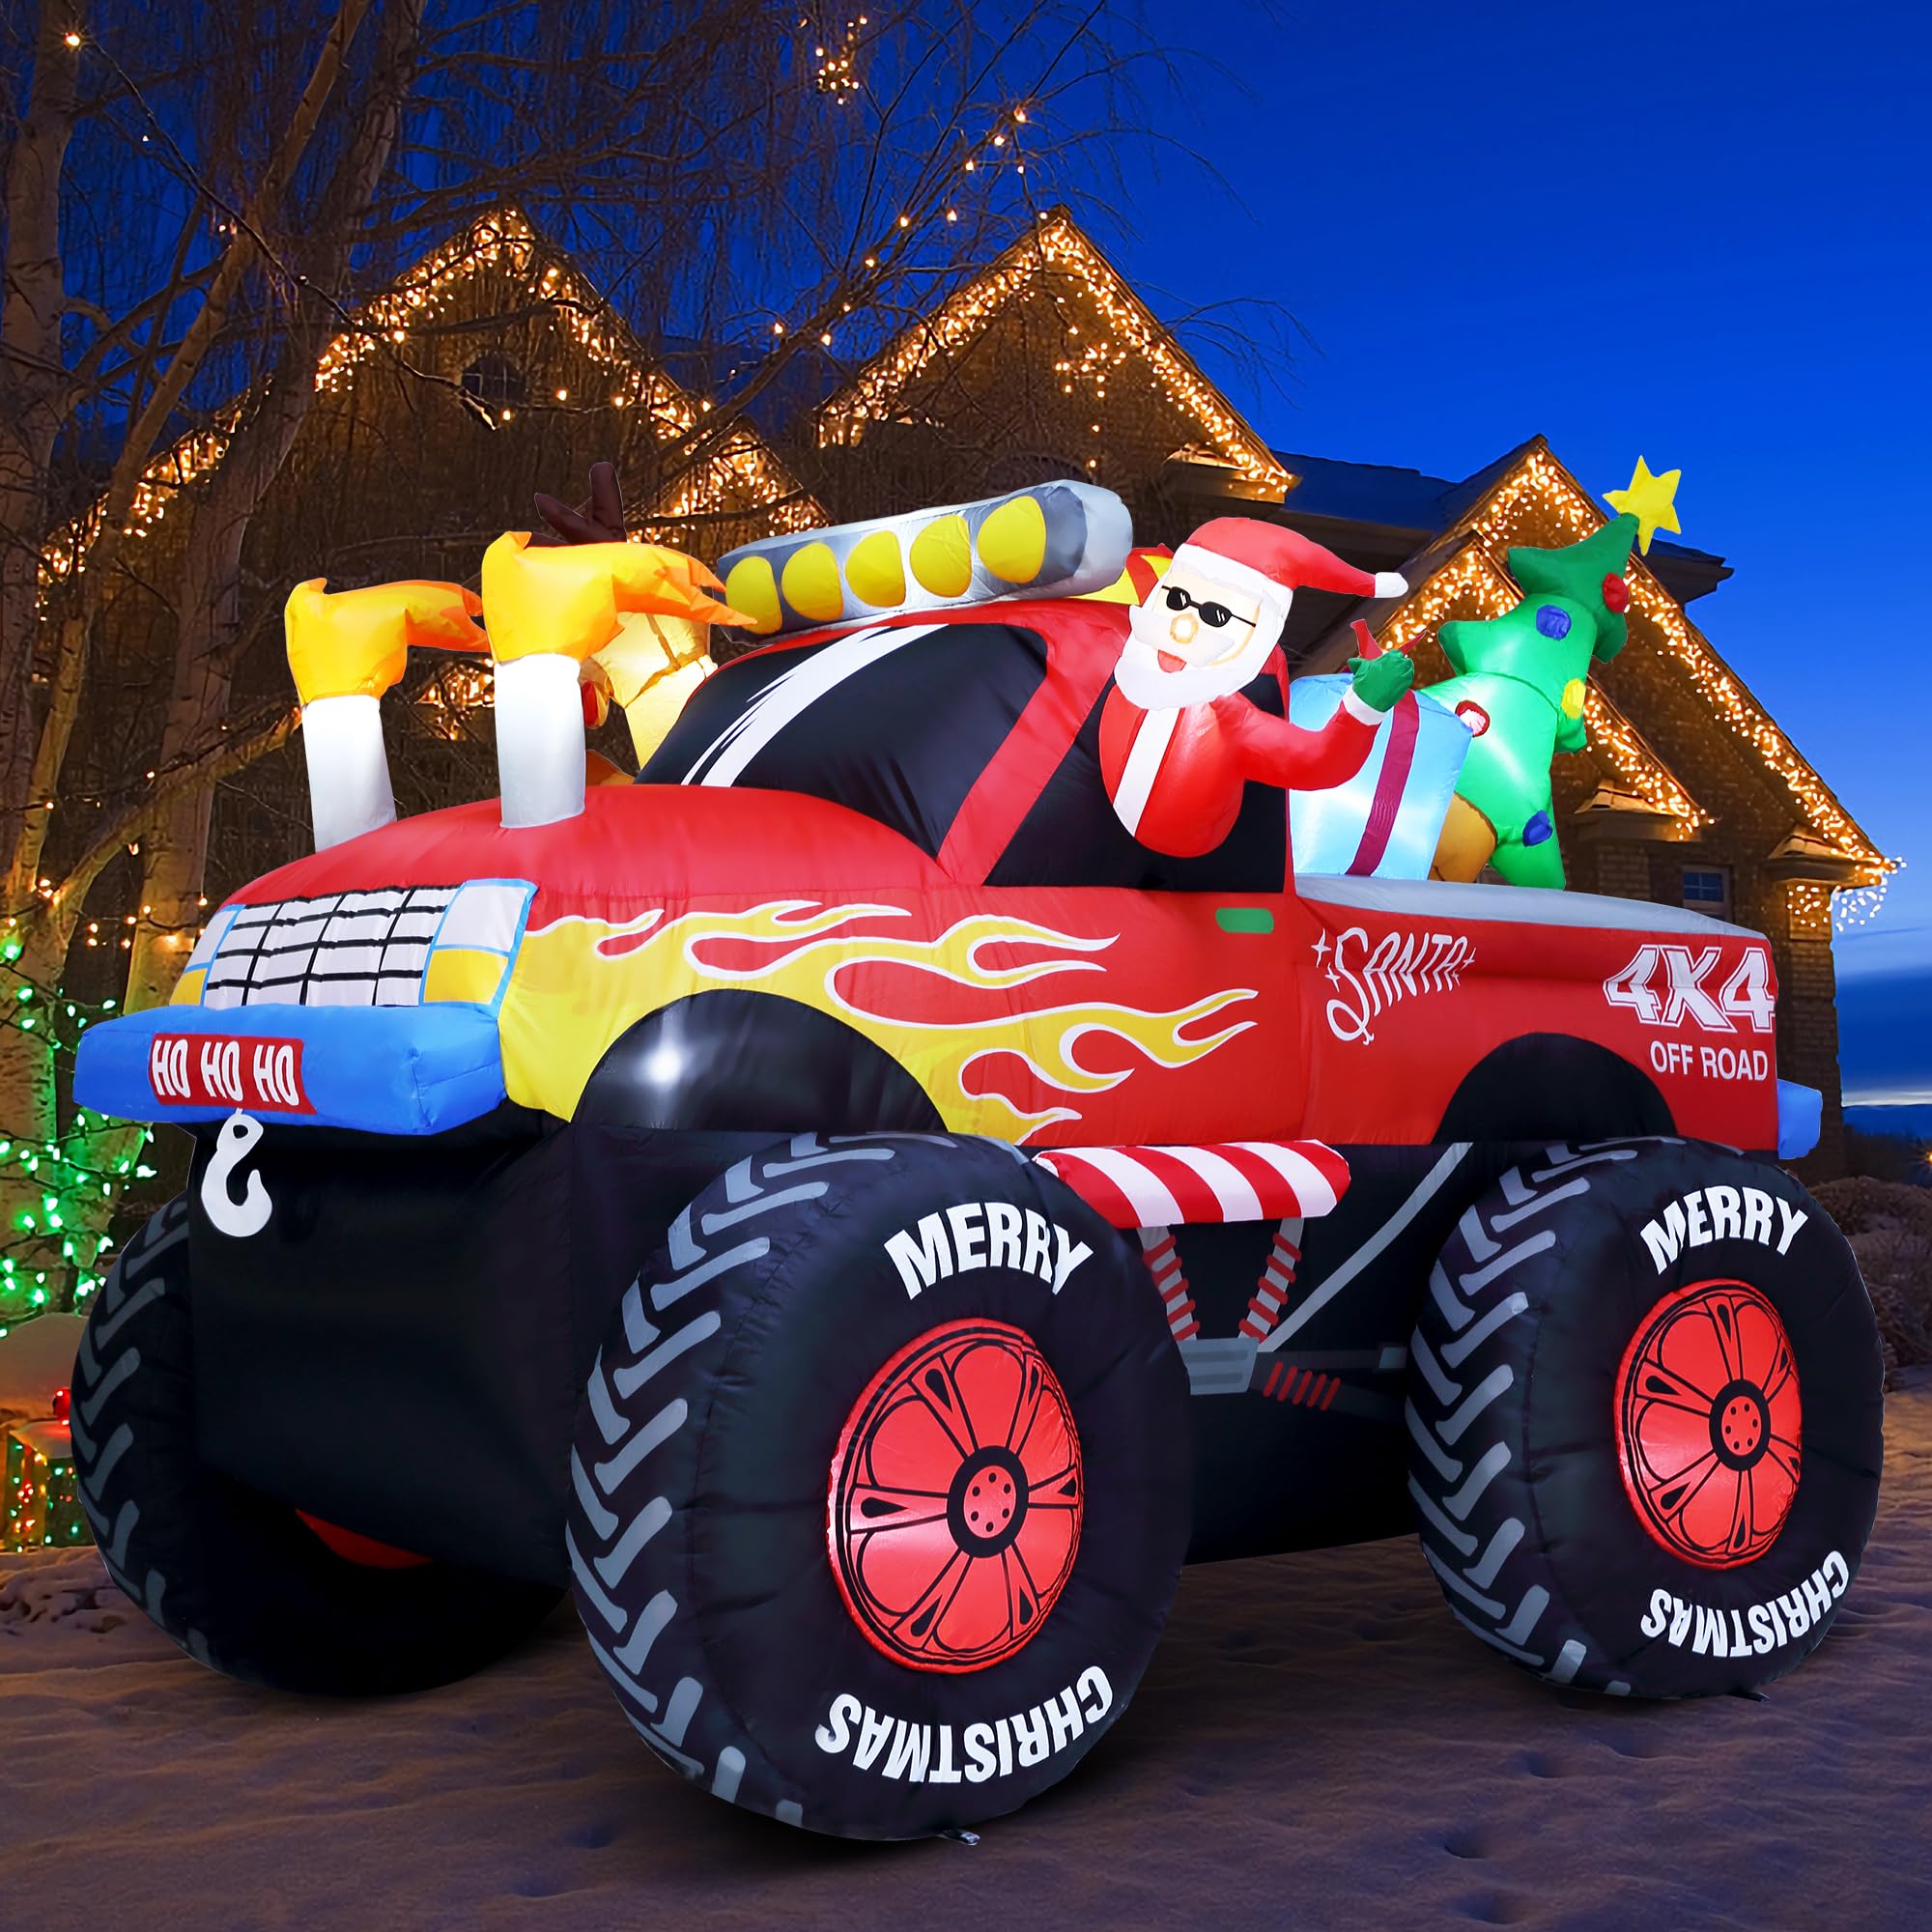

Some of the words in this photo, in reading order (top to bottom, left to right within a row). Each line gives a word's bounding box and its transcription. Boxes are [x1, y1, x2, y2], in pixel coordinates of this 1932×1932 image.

[1325, 926, 1468, 1045] SANTA
[151, 1038, 191, 1098] HO
[200, 1040, 243, 1101] HO
[253, 1044, 300, 1106] HO
[1650, 1039, 1694, 1076] OFF
[1702, 1045, 1769, 1082] ROAD
[883, 1201, 1094, 1300] MERRY
[1639, 1183, 1809, 1275] MERRY
[1640, 1549, 1850, 1659] CHRISTMAS
[814, 1664, 1115, 1784] CHRISTMAS
